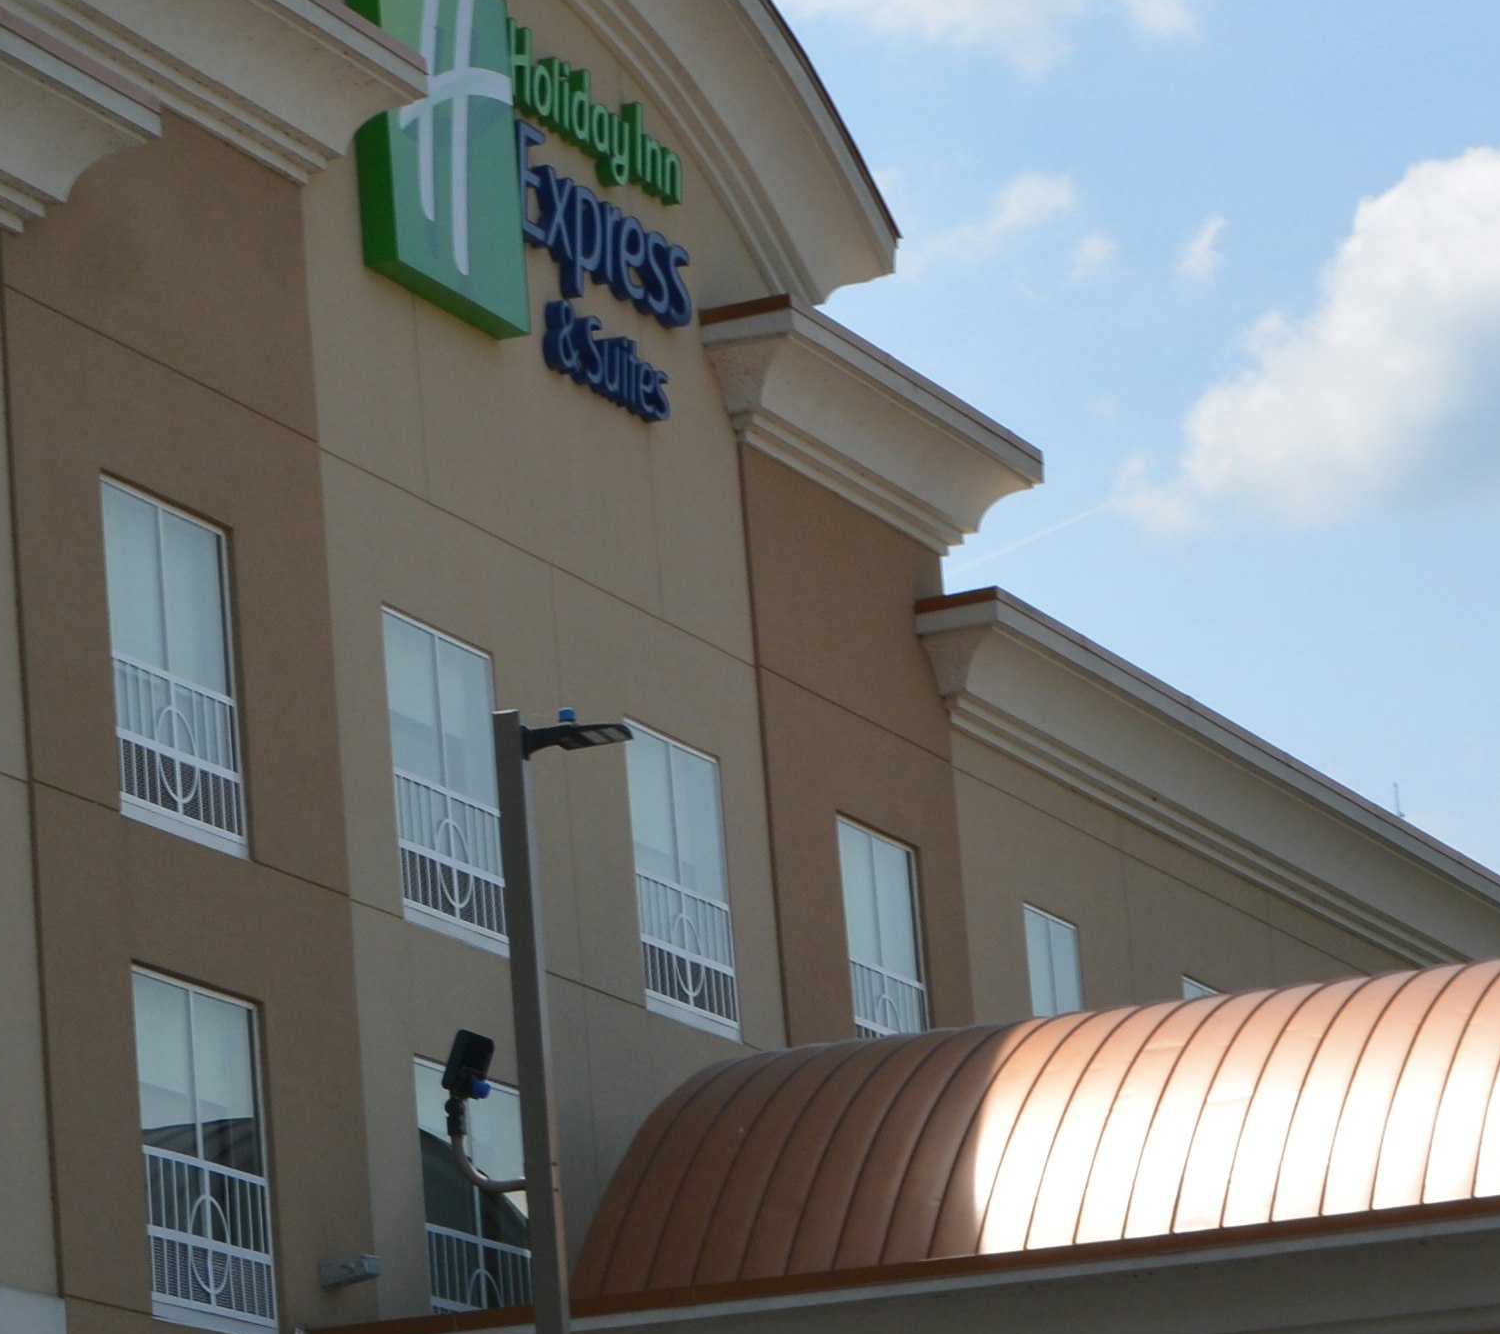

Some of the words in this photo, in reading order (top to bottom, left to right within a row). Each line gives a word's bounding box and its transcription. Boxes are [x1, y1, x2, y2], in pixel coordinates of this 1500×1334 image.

[507, 17, 630, 187] Holiday
[625, 101, 683, 205] Inn
[515, 119, 692, 329] Express
[543, 299, 581, 376] &
[575, 315, 670, 423] Suites
